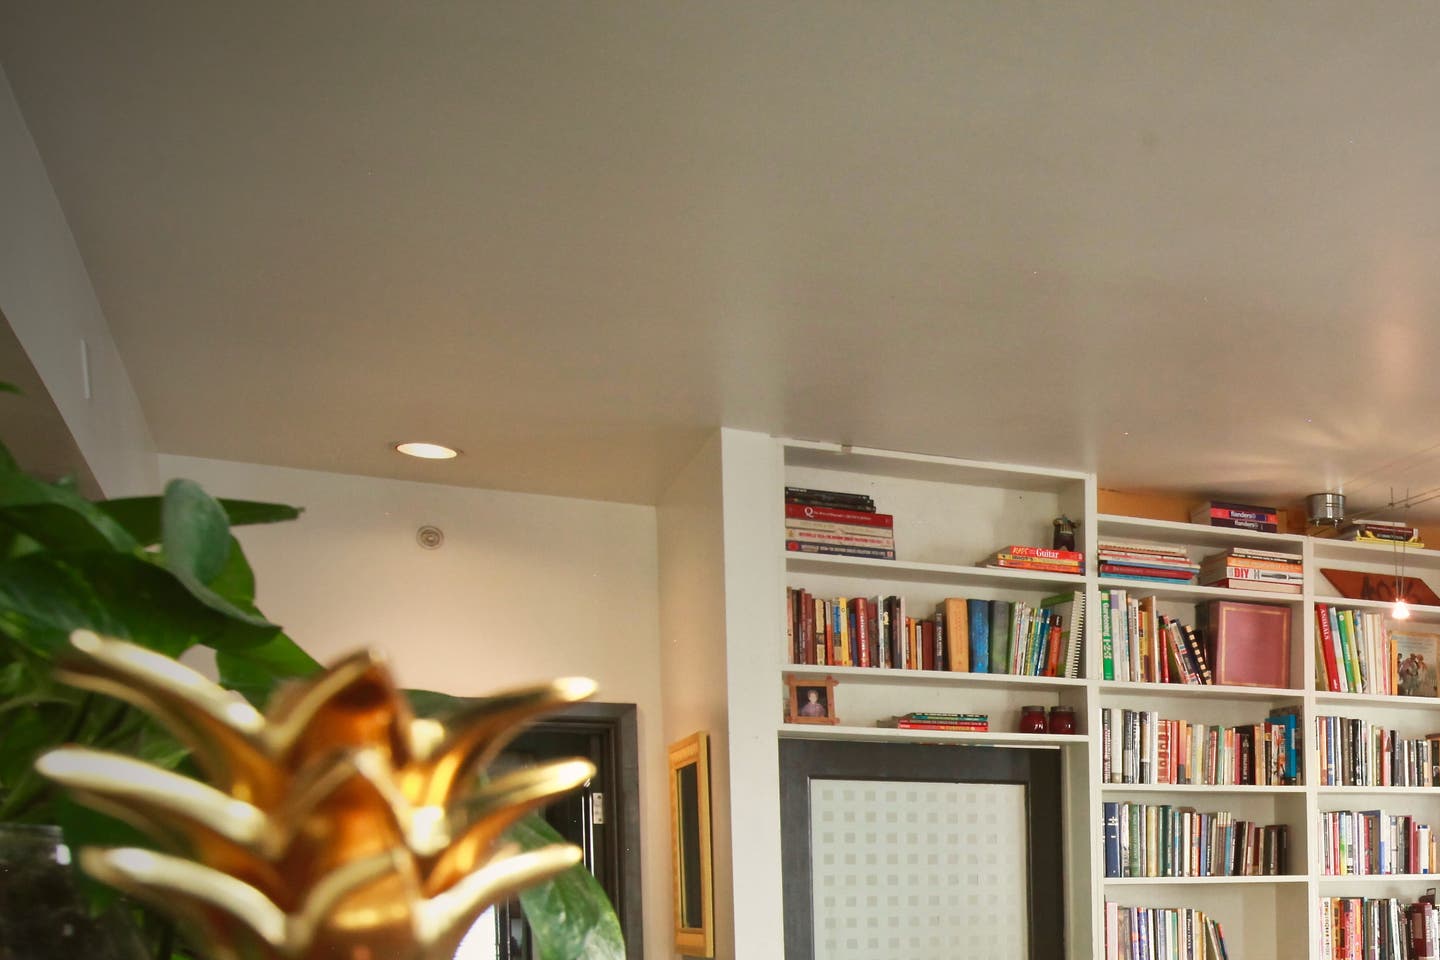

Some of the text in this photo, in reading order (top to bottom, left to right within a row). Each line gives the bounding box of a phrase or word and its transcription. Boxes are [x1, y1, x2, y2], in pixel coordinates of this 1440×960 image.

[1036, 548, 1059, 559] Guitar
[1234, 567, 1249, 579] DIY
[1320, 608, 1329, 640] ANIMALS
